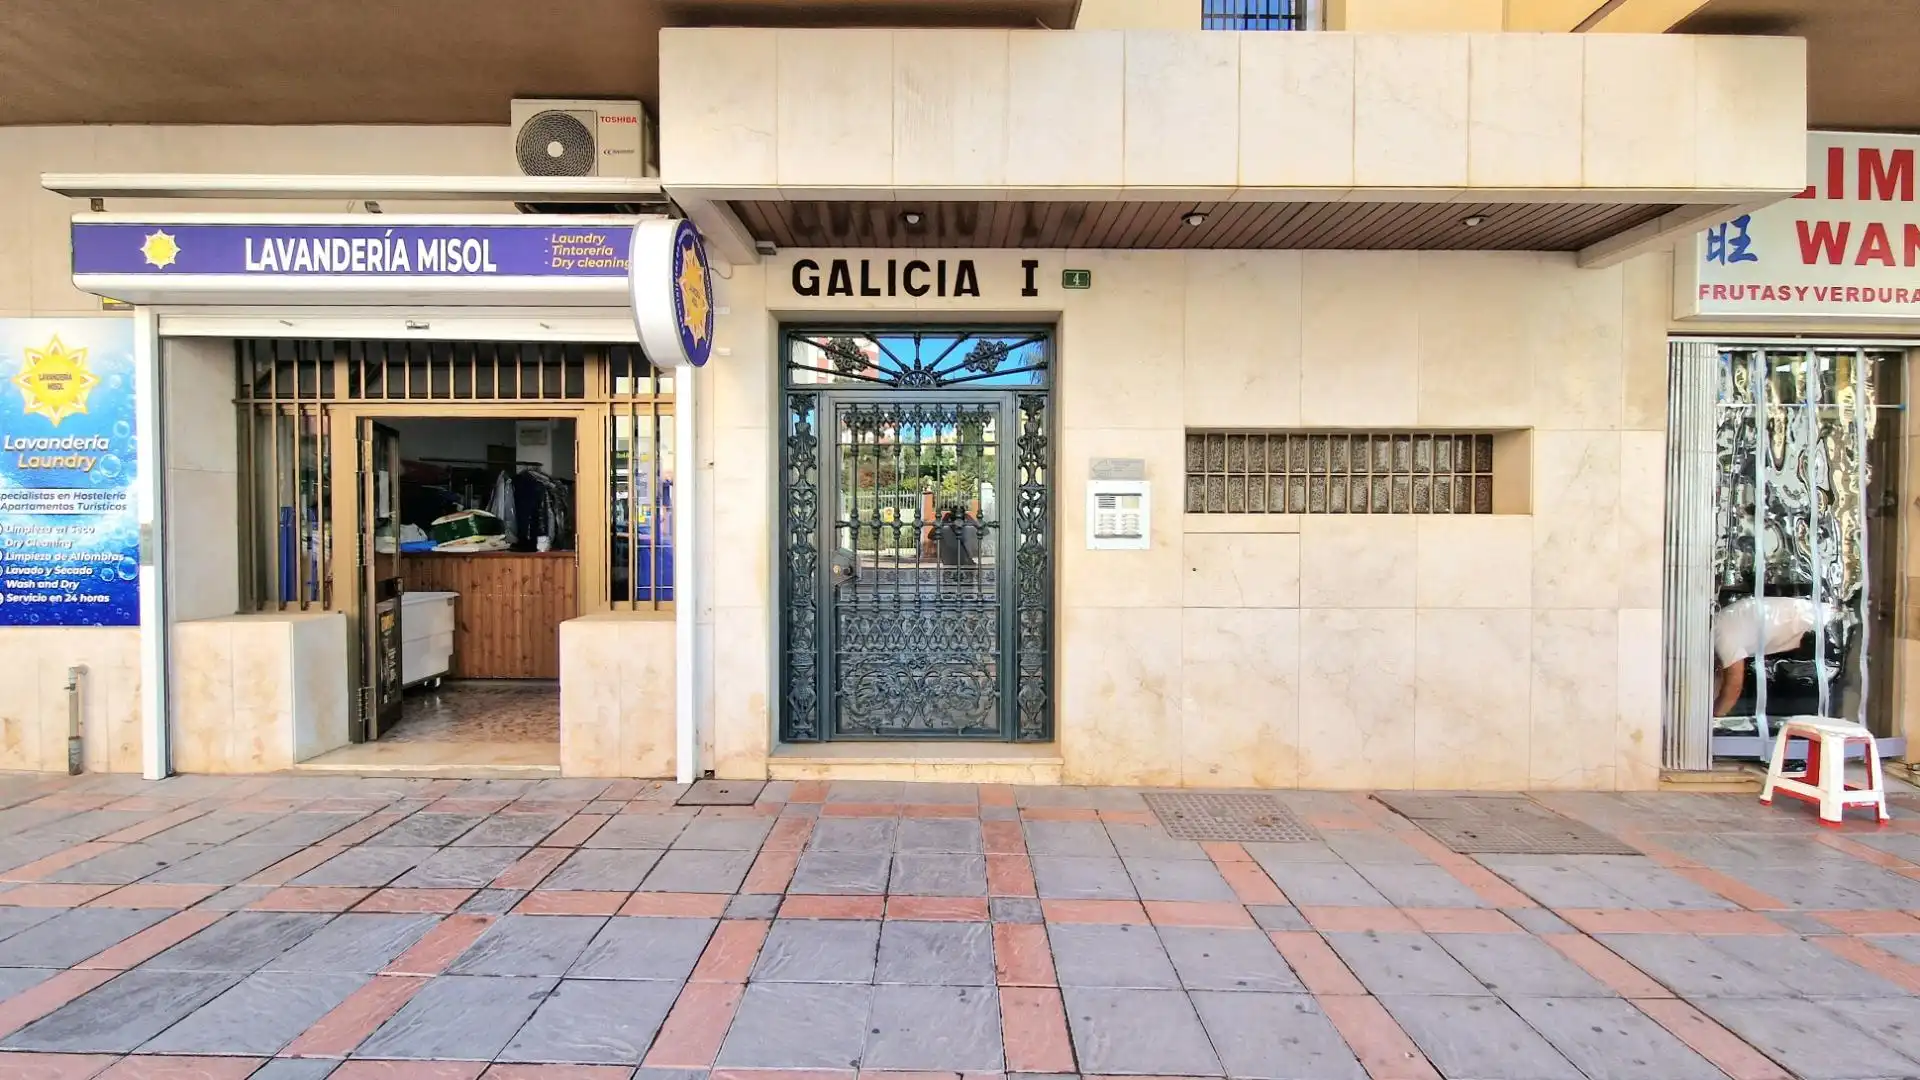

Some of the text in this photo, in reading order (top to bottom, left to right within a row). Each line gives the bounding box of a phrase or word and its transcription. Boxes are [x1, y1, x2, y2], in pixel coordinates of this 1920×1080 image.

[600, 116, 637, 124] TOSHIBA
[1791, 147, 1914, 201] IM
[551, 233, 606, 246] Laundry
[1705, 214, 1758, 266] 旺
[245, 229, 497, 272] LAVANDERÍA MISOL
[551, 257, 575, 270] Dry
[792, 259, 1039, 297] GALICIA I
[4, 433, 110, 451] Lavandería
[18, 452, 97, 473] Laundry
[0, 491, 55, 502] pecialistas
[1, 503, 75, 512] Apartamentos
[6, 552, 51, 562] Limpieza
[69, 552, 124, 561] Alfombras
[6, 566, 93, 576] Lavado y Secado
[7, 580, 80, 590] Wash and Dry
[7, 594, 47, 602] Servicio
[64, 593, 78, 602] 24
[80, 593, 110, 602] horas
